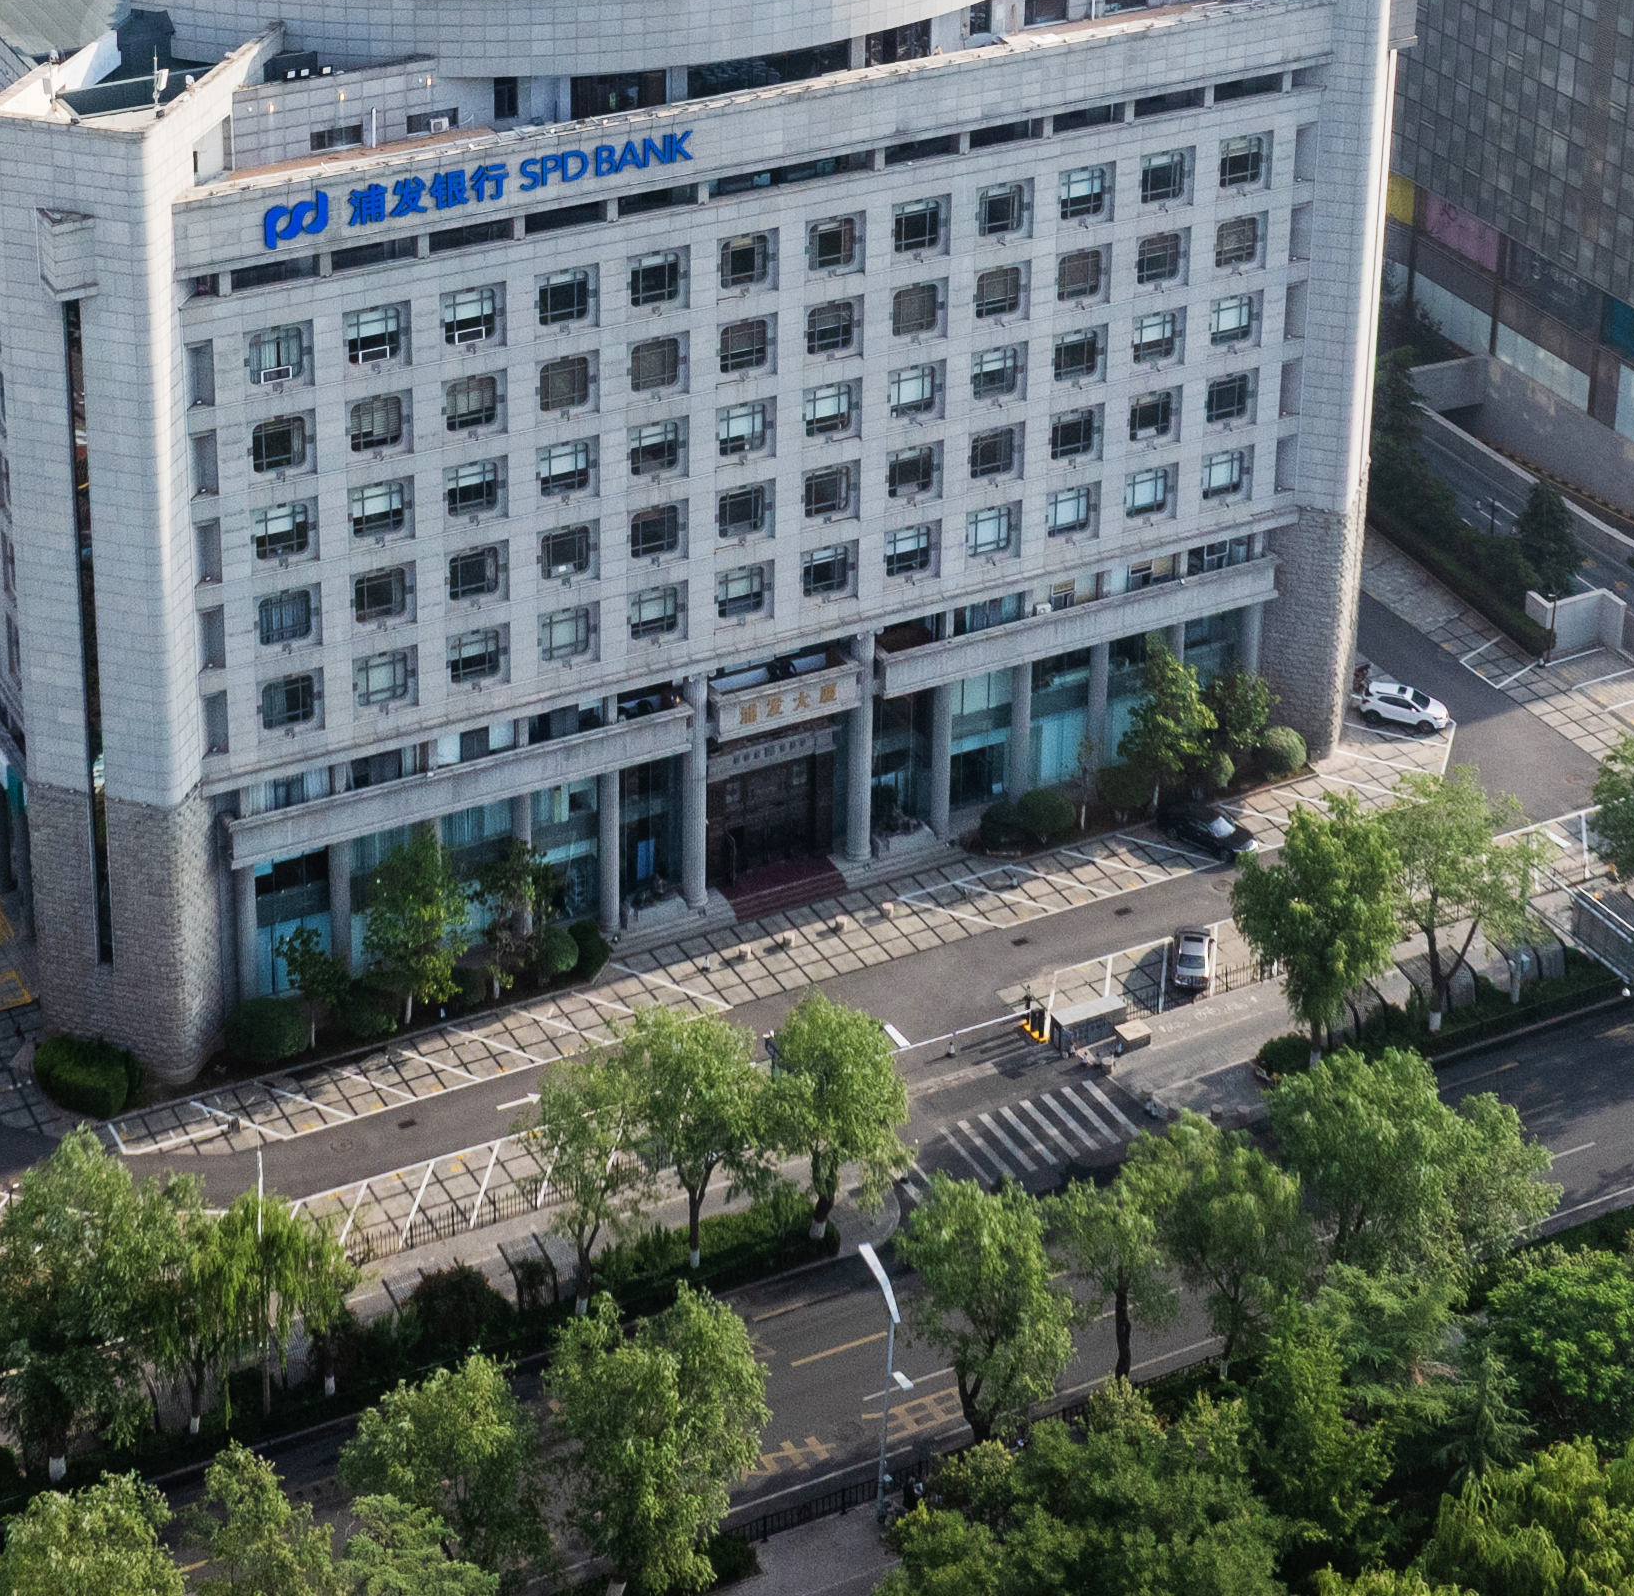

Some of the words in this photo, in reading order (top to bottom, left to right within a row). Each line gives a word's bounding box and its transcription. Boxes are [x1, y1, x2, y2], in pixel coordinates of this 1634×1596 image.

[348, 163, 508, 227] 浦发银行
[520, 150, 589, 192] SPD
[595, 129, 694, 177] BANK
